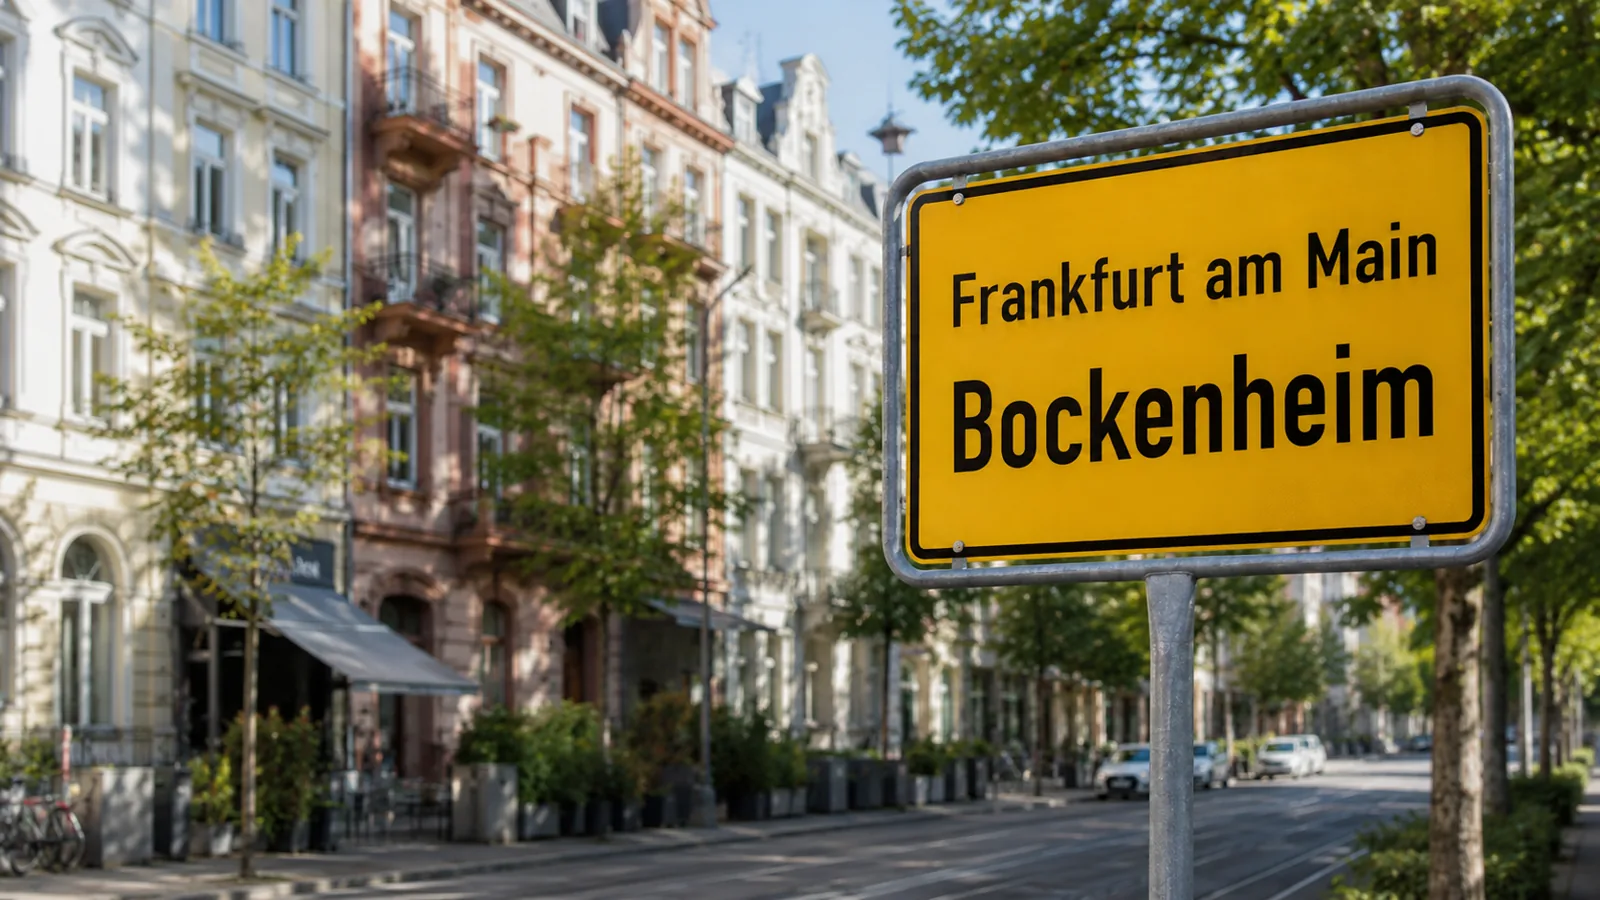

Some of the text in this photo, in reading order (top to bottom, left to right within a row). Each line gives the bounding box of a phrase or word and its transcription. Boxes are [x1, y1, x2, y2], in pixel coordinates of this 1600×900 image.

[953, 222, 1437, 328] Frankfurt am Main
[953, 343, 1434, 473] Bockenheim
